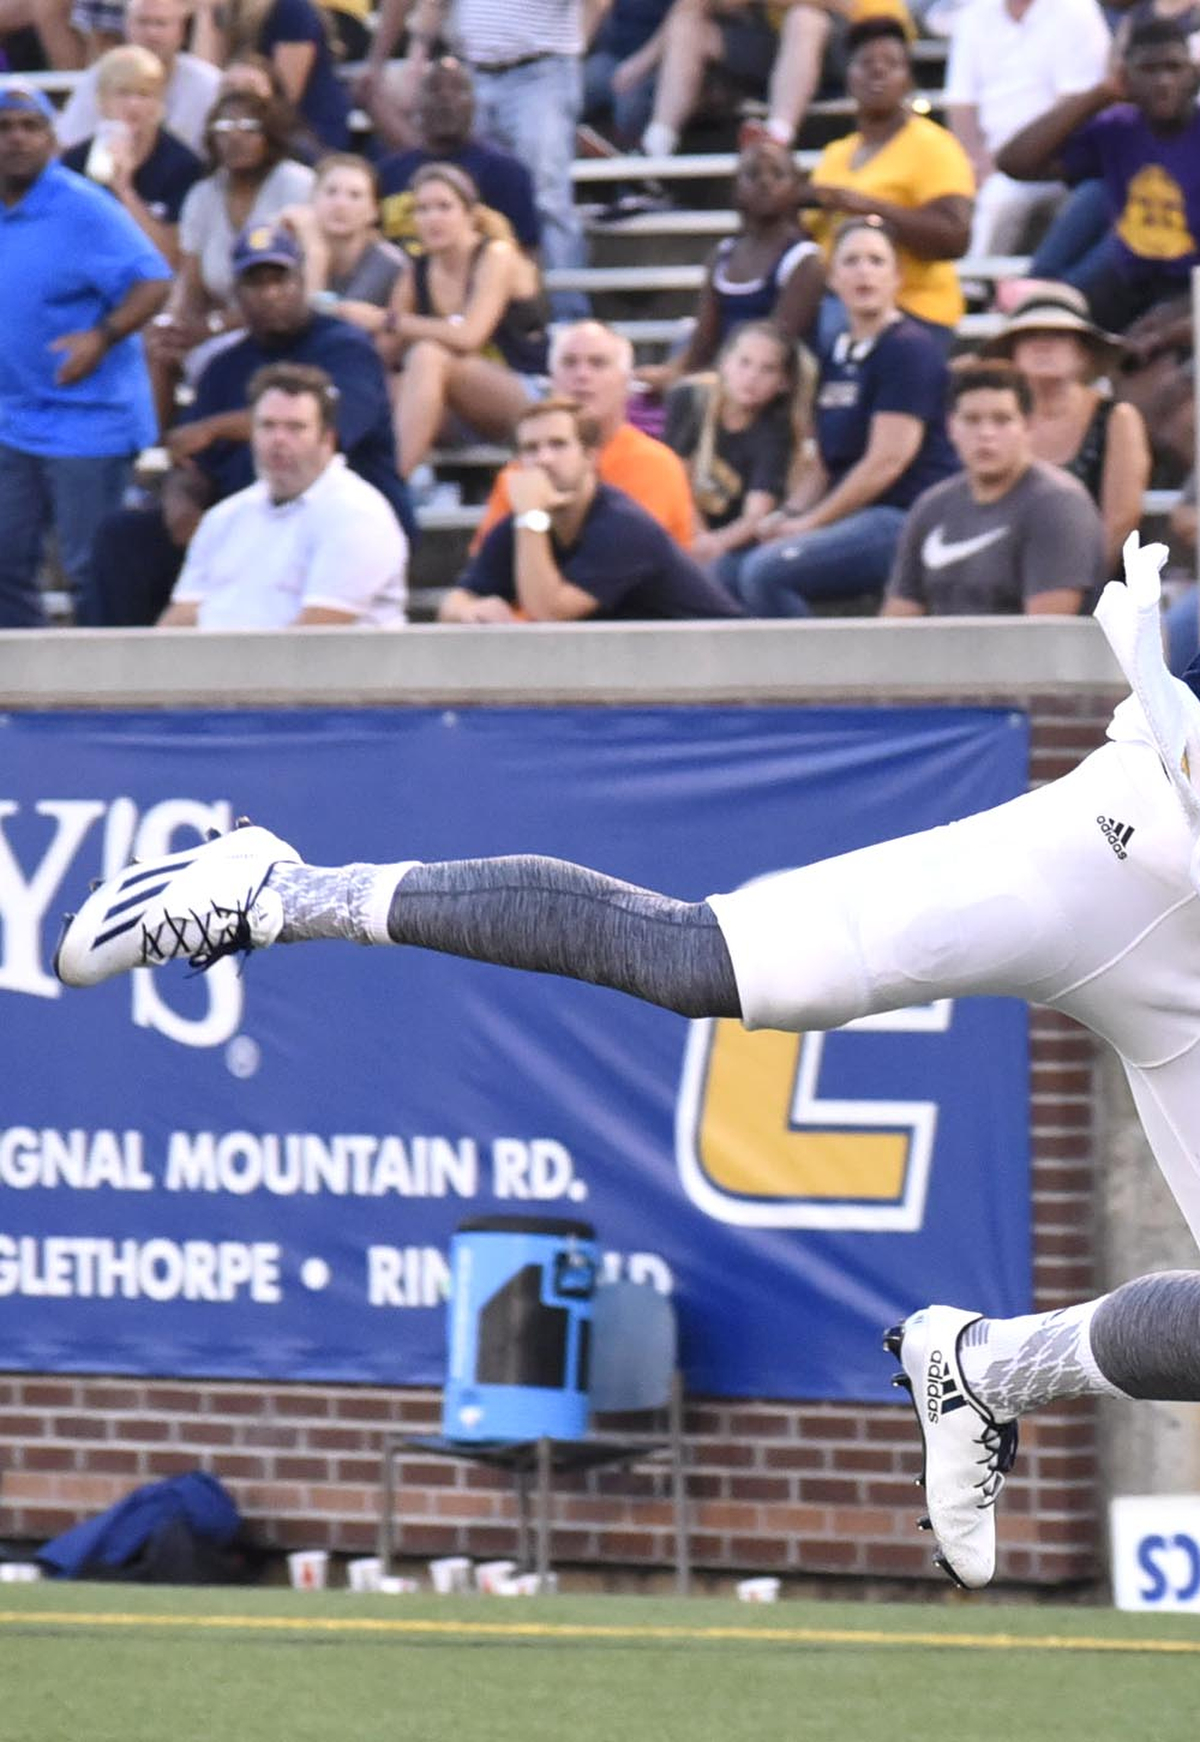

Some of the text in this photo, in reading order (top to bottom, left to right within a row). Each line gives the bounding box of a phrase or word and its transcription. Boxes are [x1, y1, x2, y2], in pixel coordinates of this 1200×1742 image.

[1096, 815, 1127, 860] adidas
[0, 1126, 588, 1201] GNAL MOUNTAIN RD.
[927, 1350, 942, 1424] adidas
